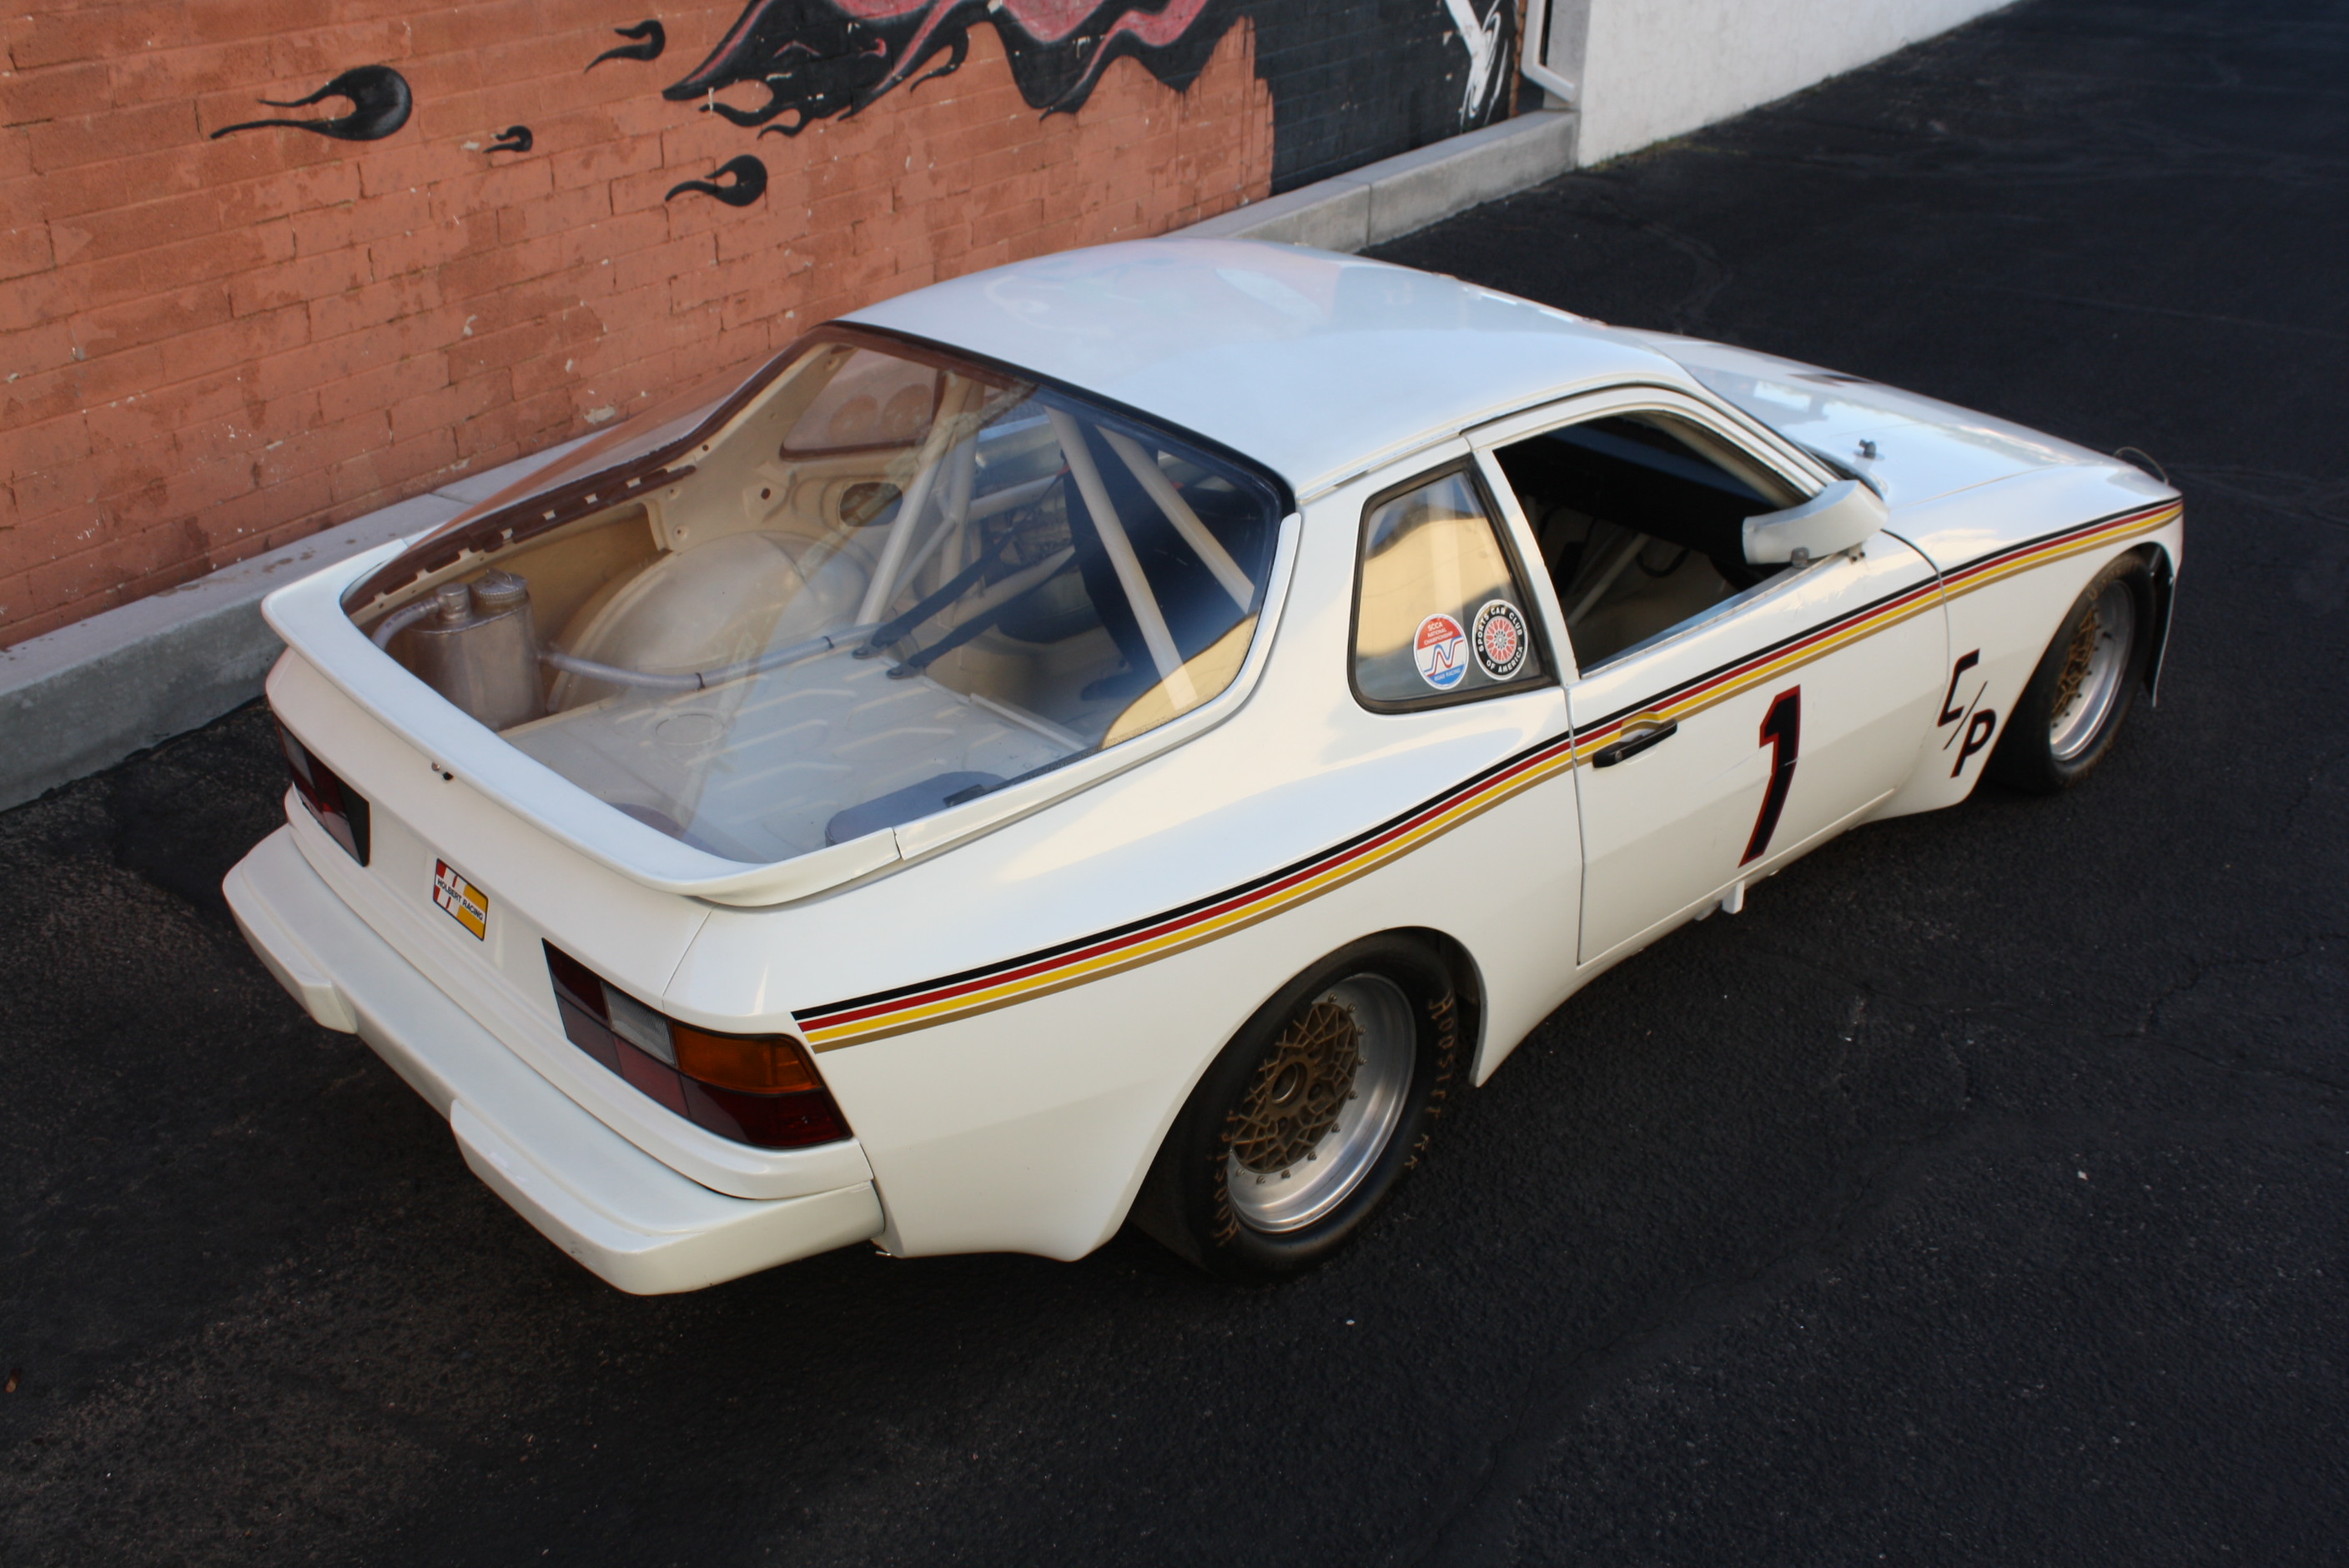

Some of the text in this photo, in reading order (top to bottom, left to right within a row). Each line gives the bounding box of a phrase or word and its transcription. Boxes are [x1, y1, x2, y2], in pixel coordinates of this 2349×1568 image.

[1427, 621, 1443, 631] SCCA
[1427, 627, 1447, 638] NATIONAL
[1477, 606, 1523, 652] SPORTS CAR CLUB
[1424, 631, 1454, 646] CHAMPIONSHIP
[1486, 646, 1523, 673] OF AMERICA
[1434, 667, 1461, 681] ROAD RACING
[1738, 684, 1801, 868] 1
[437, 877, 484, 921] HOLBERT RACING
